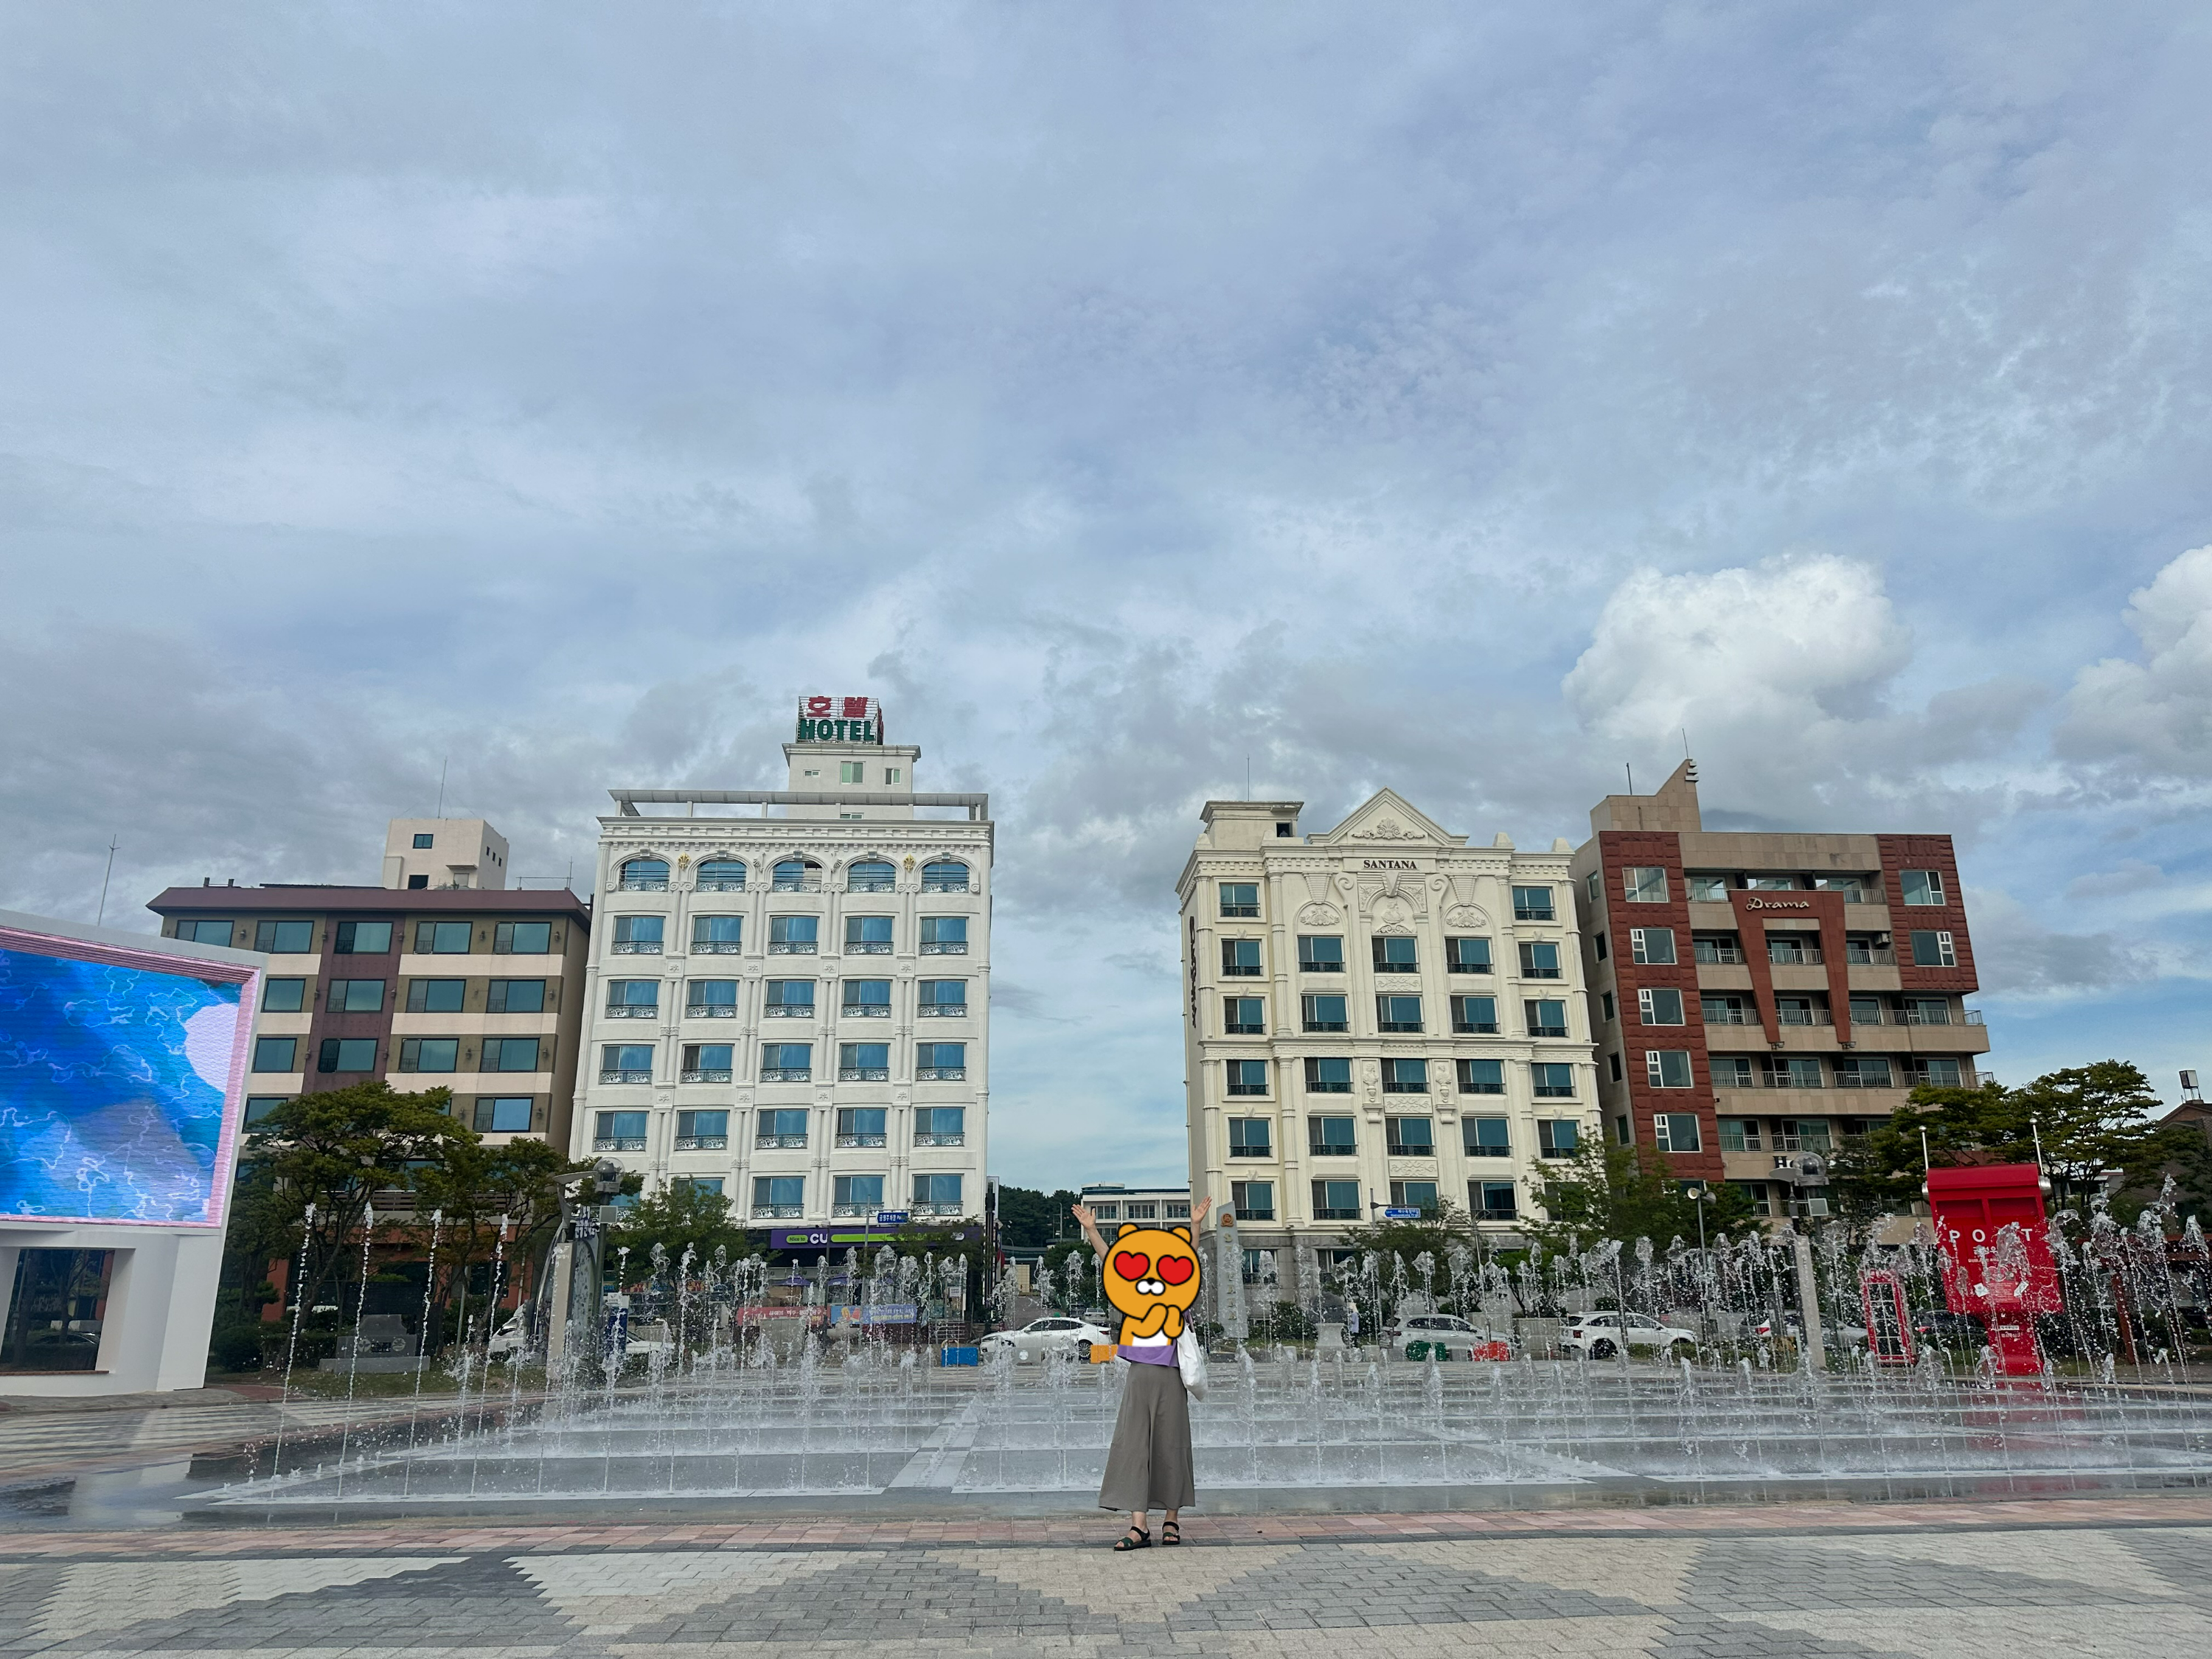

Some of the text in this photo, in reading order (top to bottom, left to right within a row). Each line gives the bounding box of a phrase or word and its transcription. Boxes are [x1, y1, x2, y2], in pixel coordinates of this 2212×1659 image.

[807, 696, 868, 718] 호텔
[800, 719, 874, 740] HOTEL
[1363, 860, 1416, 869] SANTANA
[1746, 897, 1809, 911] Drama
[810, 1233, 828, 1244] CU
[1949, 1228, 2033, 1242] POT
